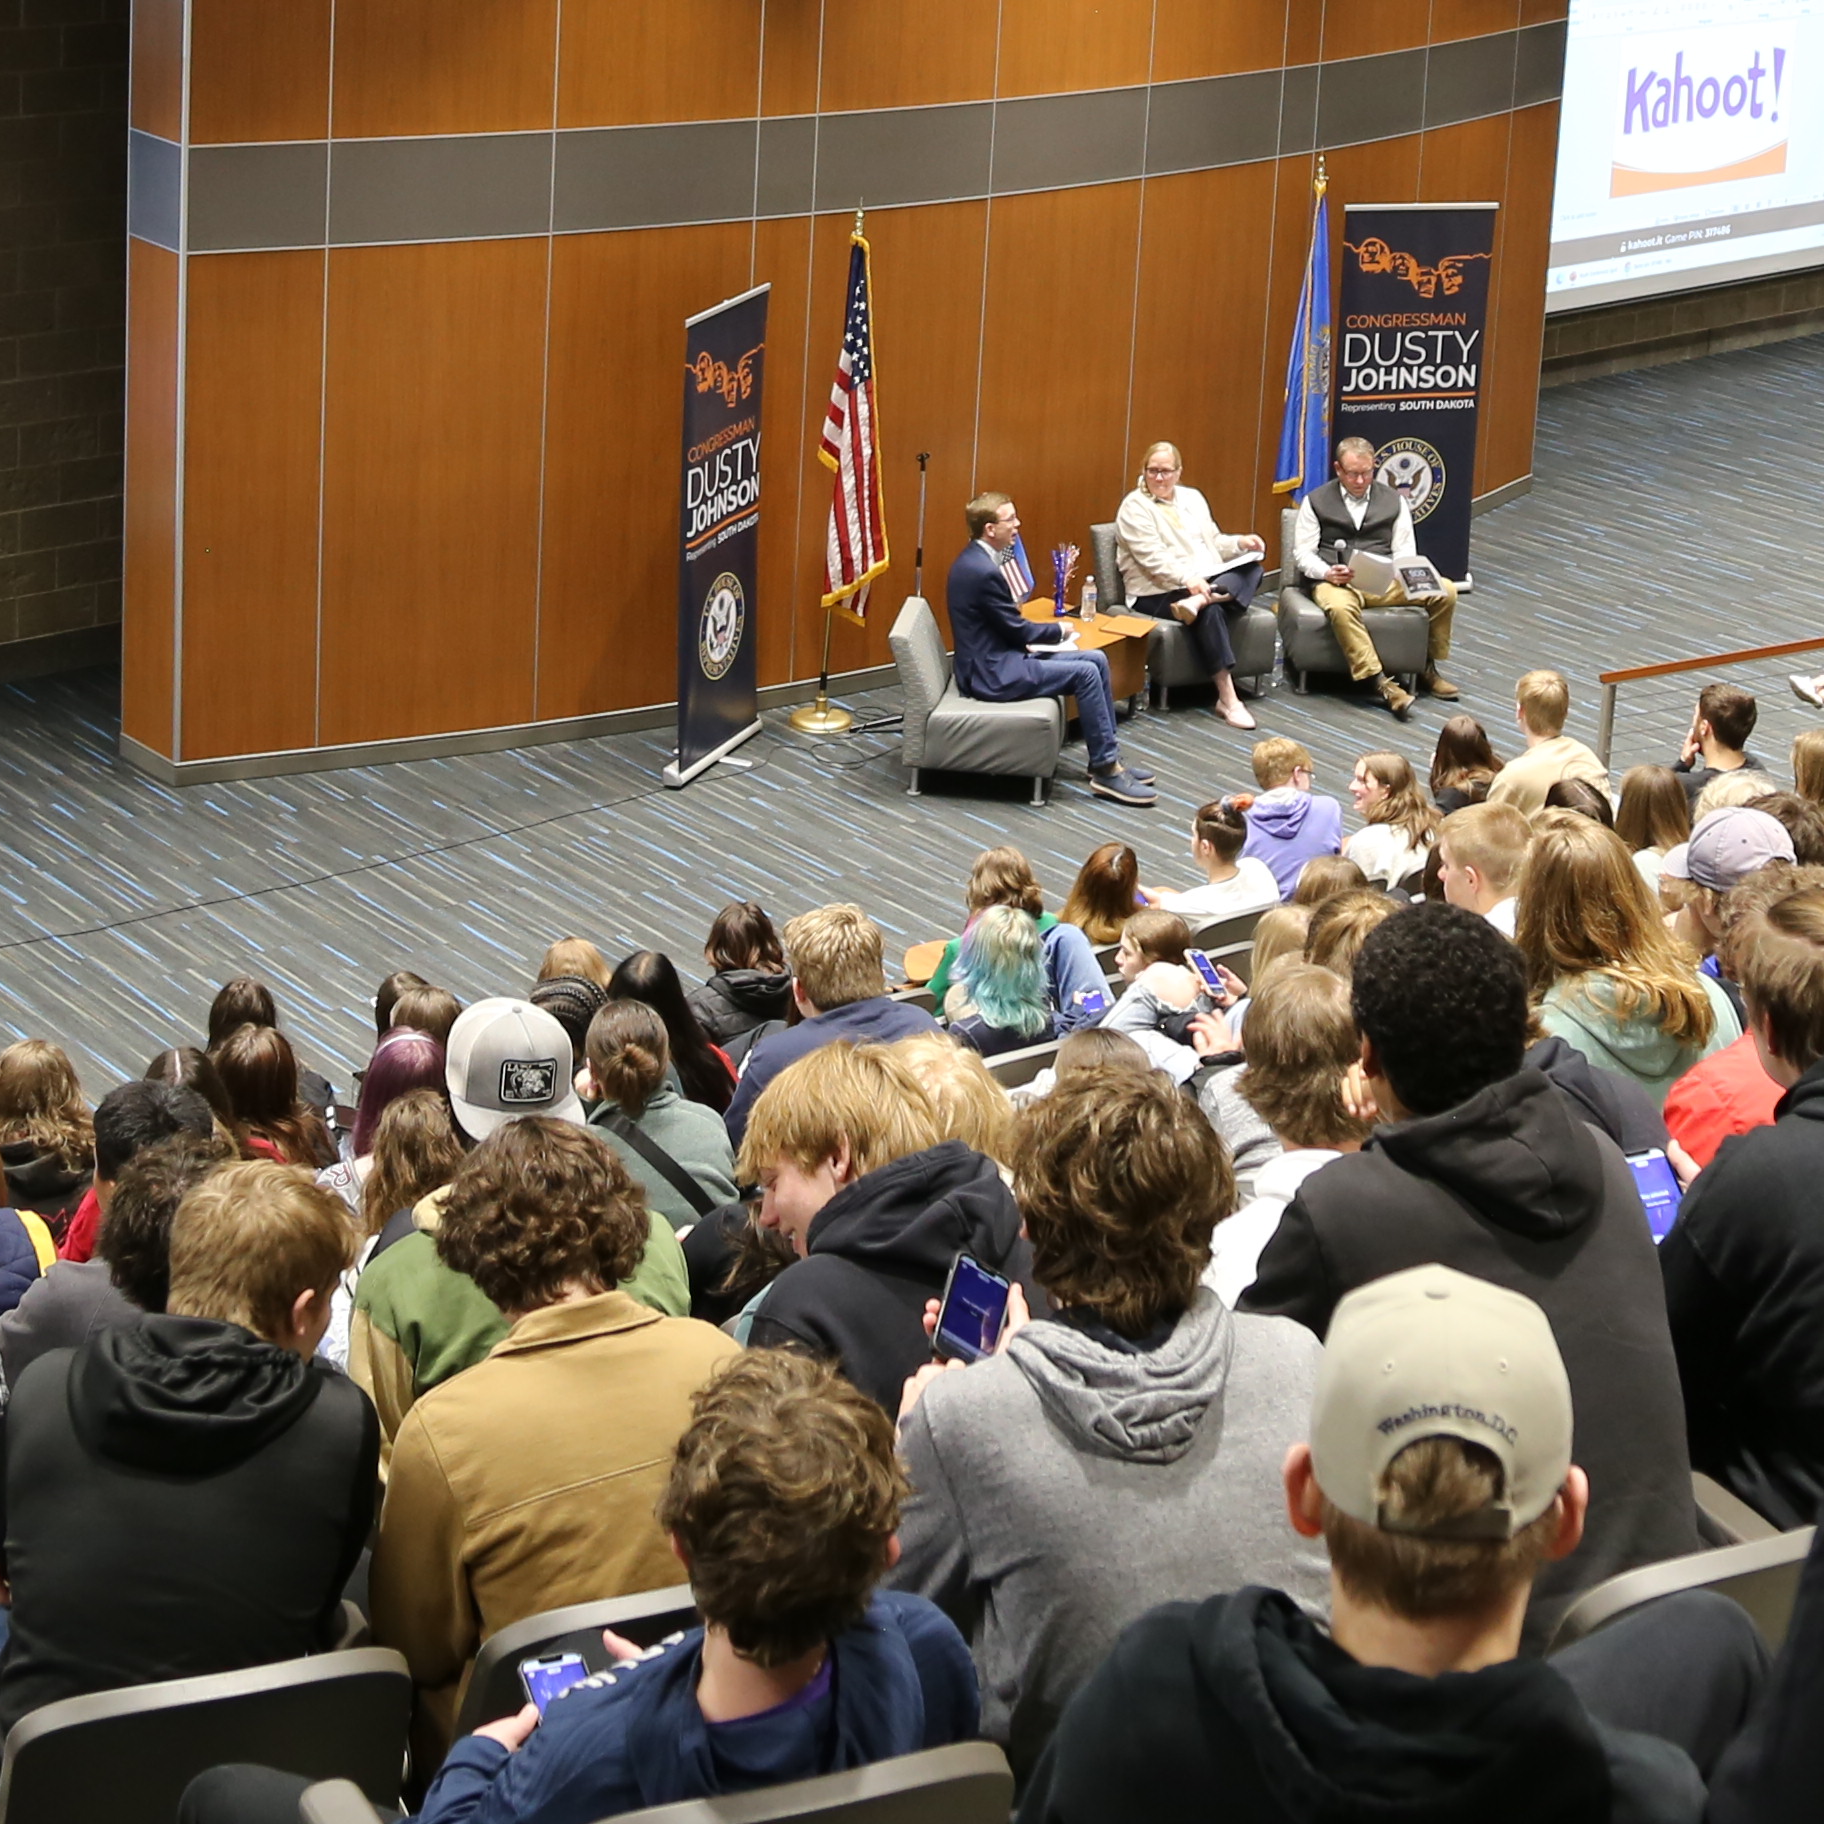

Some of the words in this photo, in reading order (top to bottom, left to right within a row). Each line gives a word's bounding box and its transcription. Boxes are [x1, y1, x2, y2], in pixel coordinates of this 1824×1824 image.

[1622, 46, 1787, 136] Kahoot!
[1627, 231, 1664, 252] kahoot.it
[1664, 230, 1687, 247] Game
[1704, 221, 1732, 240] 317486
[1346, 312, 1467, 328] CONGRESSMAN
[1343, 329, 1479, 367] DUSTY
[1342, 363, 1477, 392] JOHNSON
[1341, 402, 1396, 414] Representing
[1399, 399, 1435, 411] SOUTH
[1435, 399, 1475, 410] DAKOTA
[687, 415, 756, 463] CONGRESSMAN
[1392, 440, 1427, 457] HOUSE
[1428, 453, 1442, 469] OF
[687, 431, 761, 509] DUSTY
[686, 472, 760, 538] JOHNSON
[717, 523, 737, 545] SOUTH
